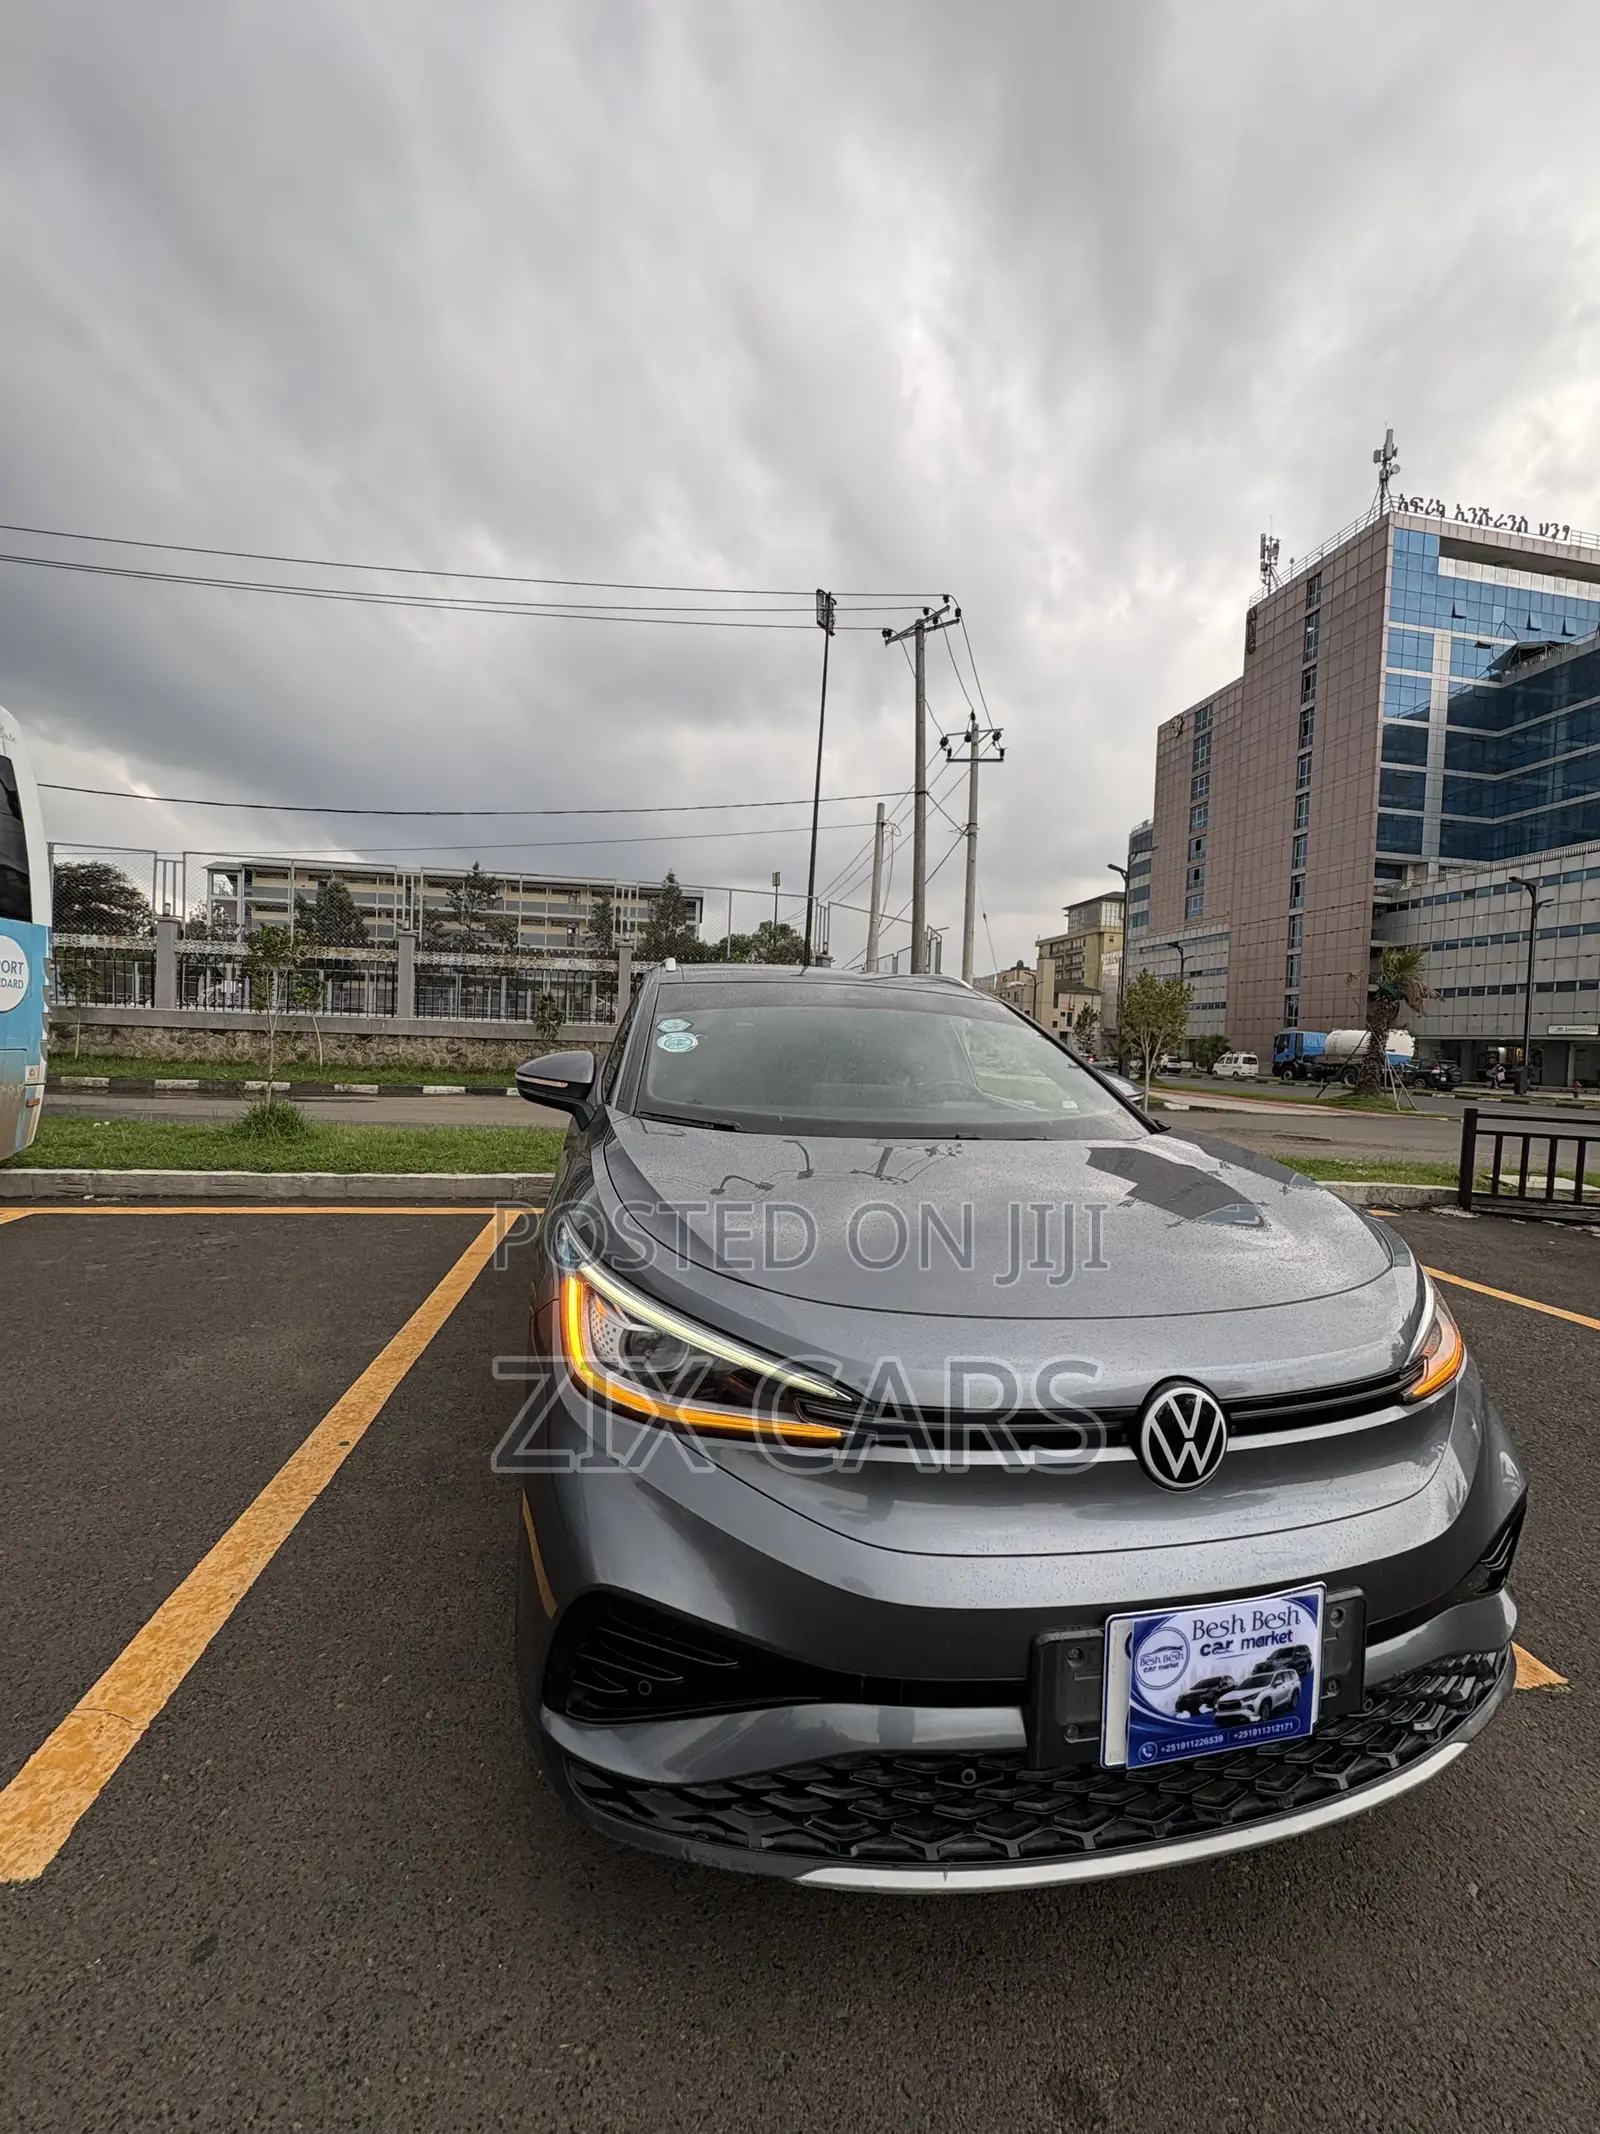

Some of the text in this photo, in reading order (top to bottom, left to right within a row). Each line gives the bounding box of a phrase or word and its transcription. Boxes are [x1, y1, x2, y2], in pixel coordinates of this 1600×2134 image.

[1398, 493, 1446, 517] አፍሪካ
[0, 960, 24, 975] ORT
[0, 978, 24, 990] DARD
[1147, 1389, 1223, 1482] VW
[1192, 1605, 1301, 1641] Besh Besh
[1200, 1629, 1293, 1657] car market
[1140, 1650, 1184, 1667] Besh Besh
[1161, 1722, 1294, 1753] +251911226539 +251911312171
